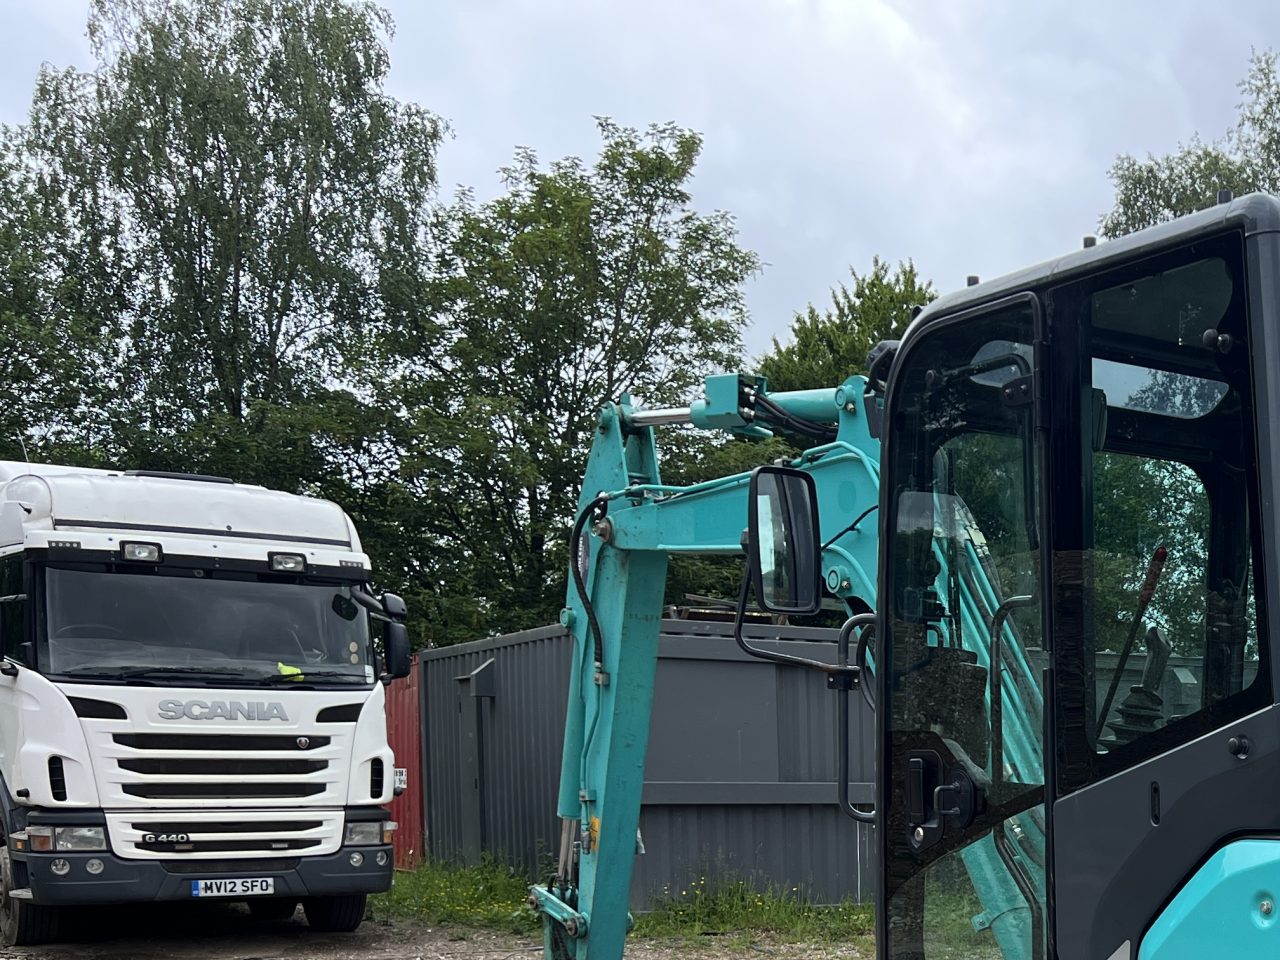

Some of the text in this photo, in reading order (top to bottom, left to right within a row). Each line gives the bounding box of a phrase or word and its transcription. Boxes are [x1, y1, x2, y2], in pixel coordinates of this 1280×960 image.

[158, 699, 289, 721] SCANIA
[145, 833, 188, 842] G 440
[203, 879, 269, 894] MV12 SFO
